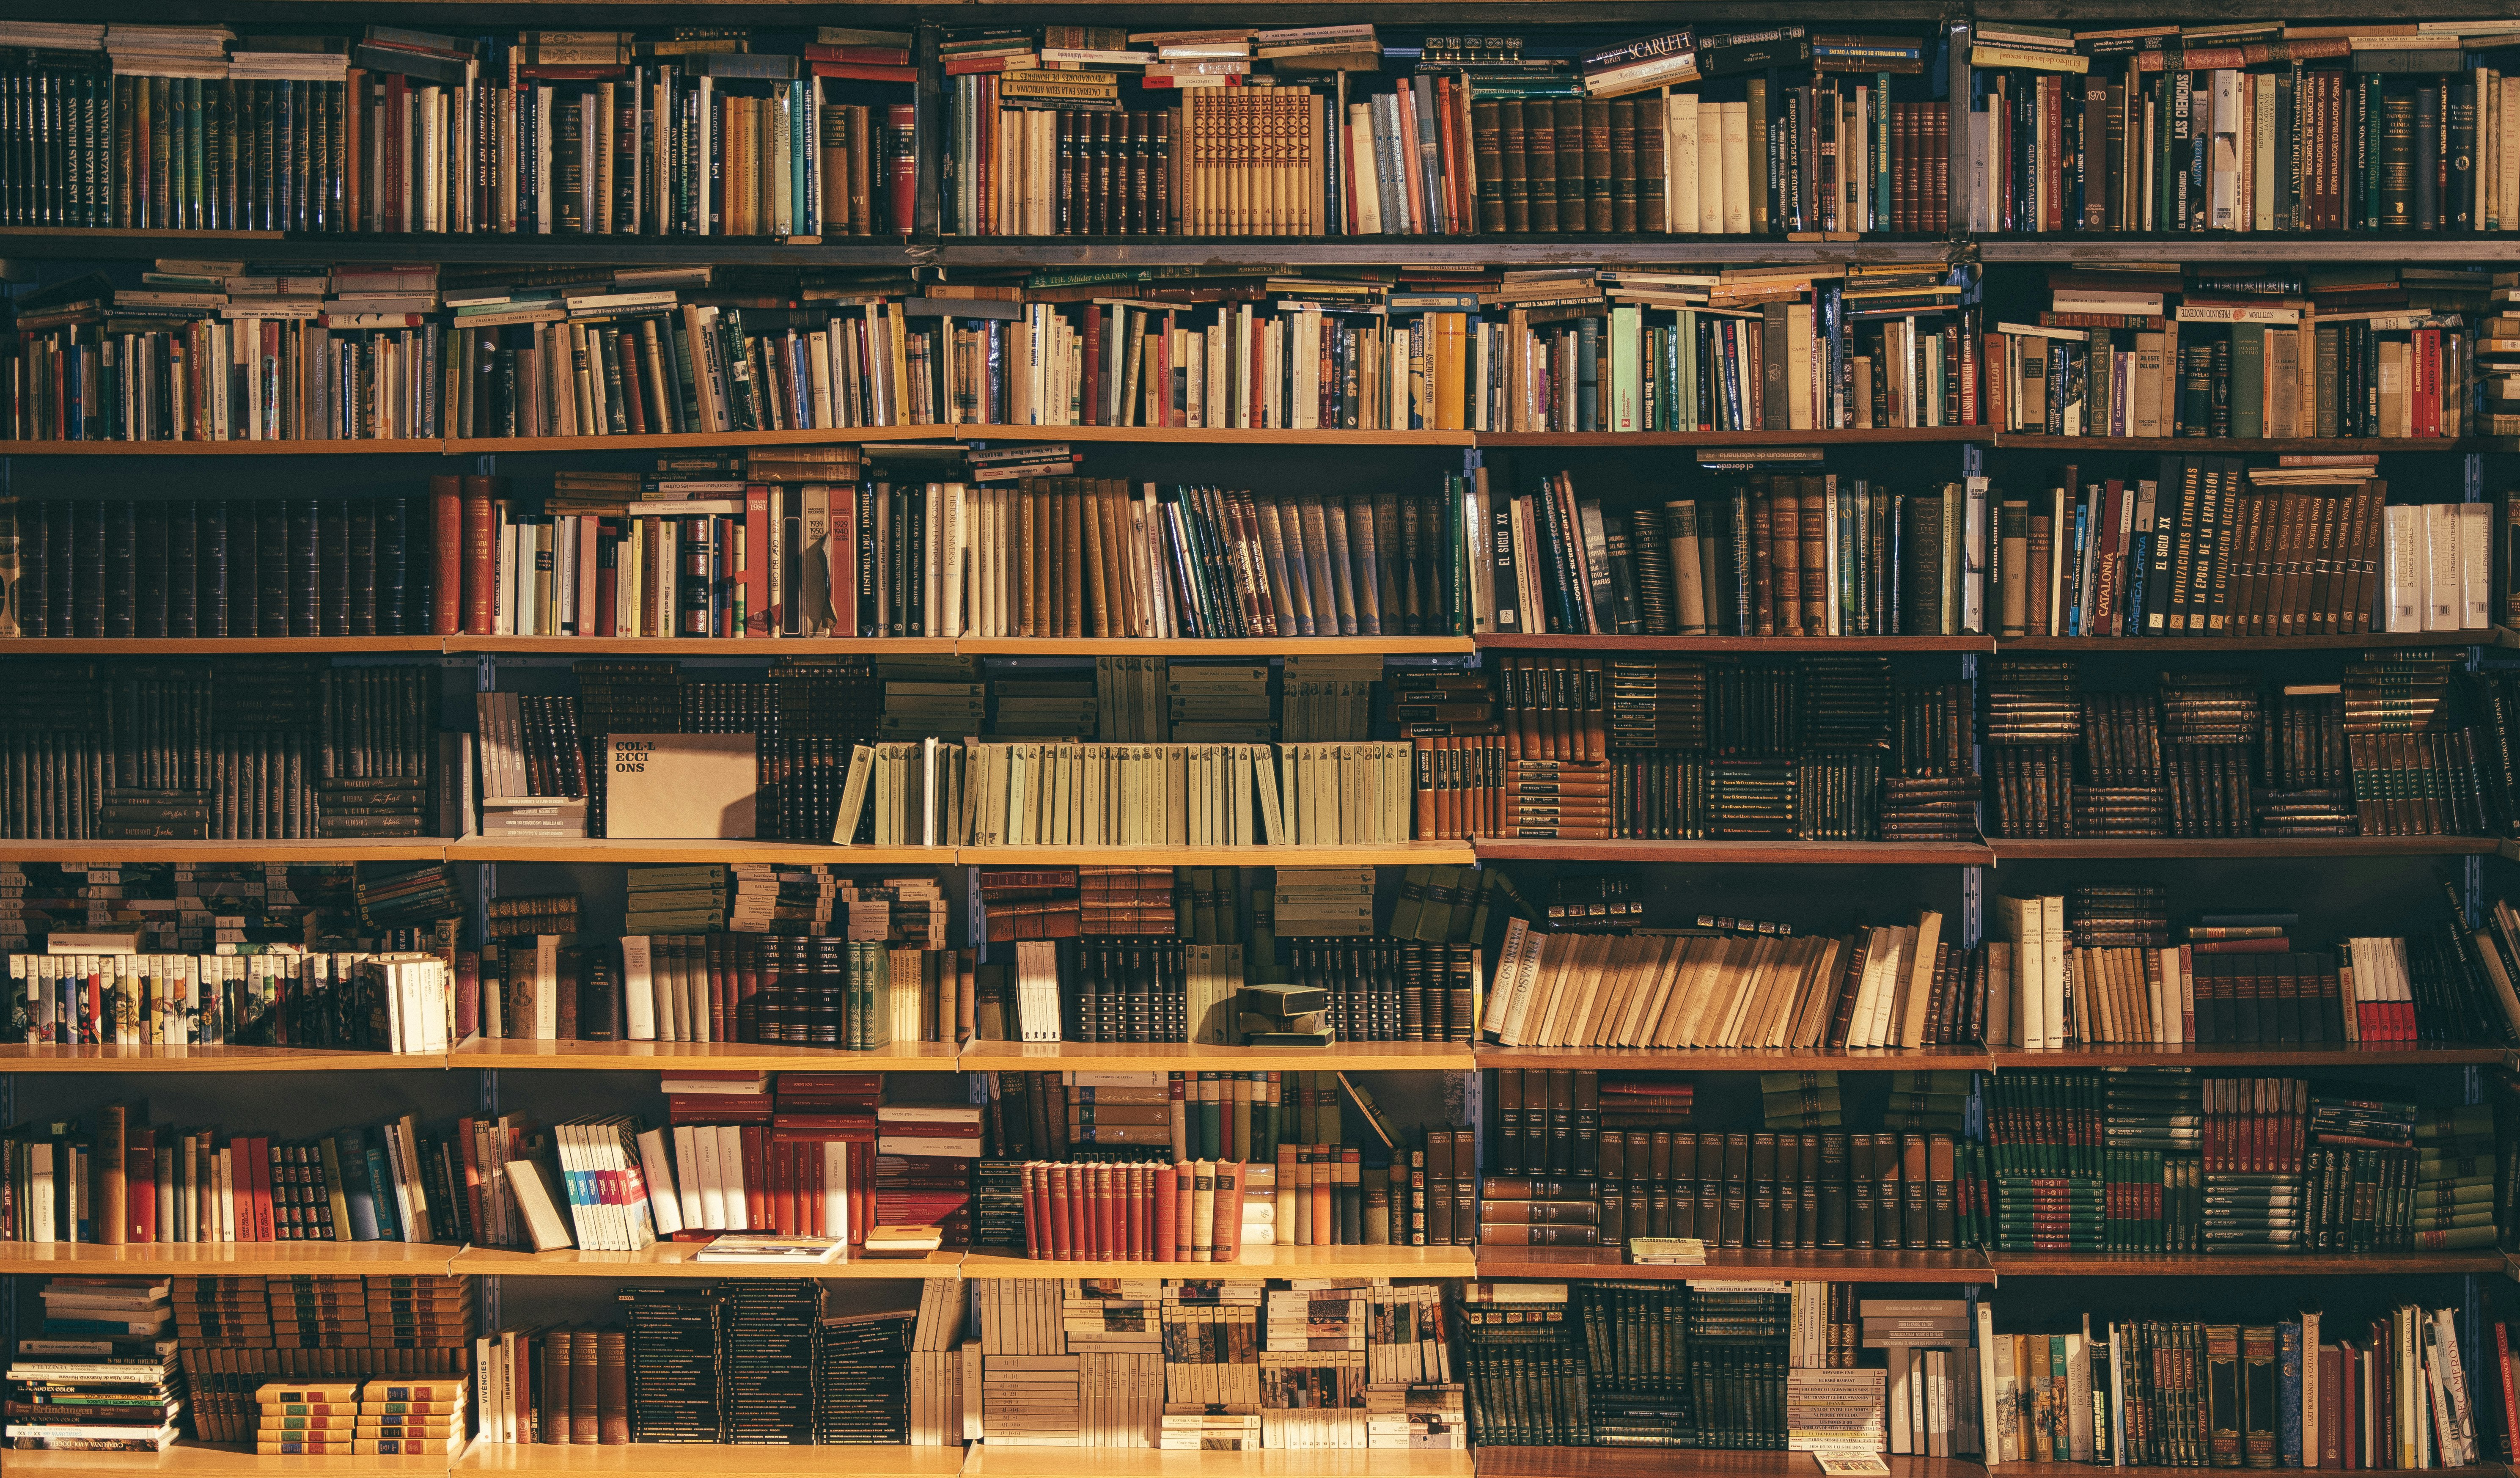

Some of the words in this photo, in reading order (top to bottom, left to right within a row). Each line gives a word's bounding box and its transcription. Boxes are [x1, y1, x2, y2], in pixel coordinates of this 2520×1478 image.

[1628, 32, 1691, 60] SCARLETT
[1595, 48, 1627, 60] ALEXANDRA
[1999, 52, 2022, 61] sexual
[2023, 53, 2038, 62] vida
[2038, 55, 2045, 63] la
[1604, 56, 1621, 64] RIPLEY
[2045, 55, 2055, 64] de
[2055, 56, 2072, 66] libro
[2073, 58, 2080, 66] El
[1020, 72, 1048, 81] HOMBRES
[1051, 73, 1058, 81] DE
[1061, 74, 1105, 83] DEVORADORES
[2088, 91, 2106, 100] 1970
[2174, 74, 2191, 118] CIENCIAS
[1194, 95, 1204, 168] BRICOLAJE
[1206, 95, 1215, 168] BRICOLAJE
[2174, 120, 2188, 139] LAS
[2307, 126, 2313, 136] DE
[2317, 134, 2323, 142] TO
[712, 166, 717, 175] 5
[852, 196, 864, 204] VI
[1067, 275, 1092, 283] Milder
[2181, 308, 2205, 317] INOCENTE
[2206, 309, 2230, 318] PRESUNTO
[1962, 363, 1973, 394] FREDERICK
[1962, 395, 1973, 420] FORSYTH
[1645, 401, 1653, 429] Benson
[2180, 467, 2198, 527] EXTINGUIDAS
[2201, 471, 2219, 523] EXPANSIÓN
[1497, 513, 1508, 524] XX
[2201, 528, 2212, 538] LA
[2214, 592, 2224, 603] LA
[2221, 470, 2239, 526] OCCIDENTAL
[1498, 531, 1509, 552] SIGLO
[2200, 543, 2211, 555] DE
[1498, 556, 1509, 565] EL
[2172, 531, 2192, 603] CIVILIZACIONES
[2193, 560, 2209, 589] ÉPOCA
[2097, 551, 2114, 617] CATALONIA
[2195, 592, 2205, 603] LA
[2494, 697, 2503, 723] ESPAÑA
[2499, 726, 2505, 735] DE
[616, 752, 649, 761] ECCI
[2501, 738, 2510, 769] TESOROS
[616, 763, 644, 772] ONS
[1499, 927, 1522, 983] PARNASO
[33, 1405, 93, 1415] Erfindungen
